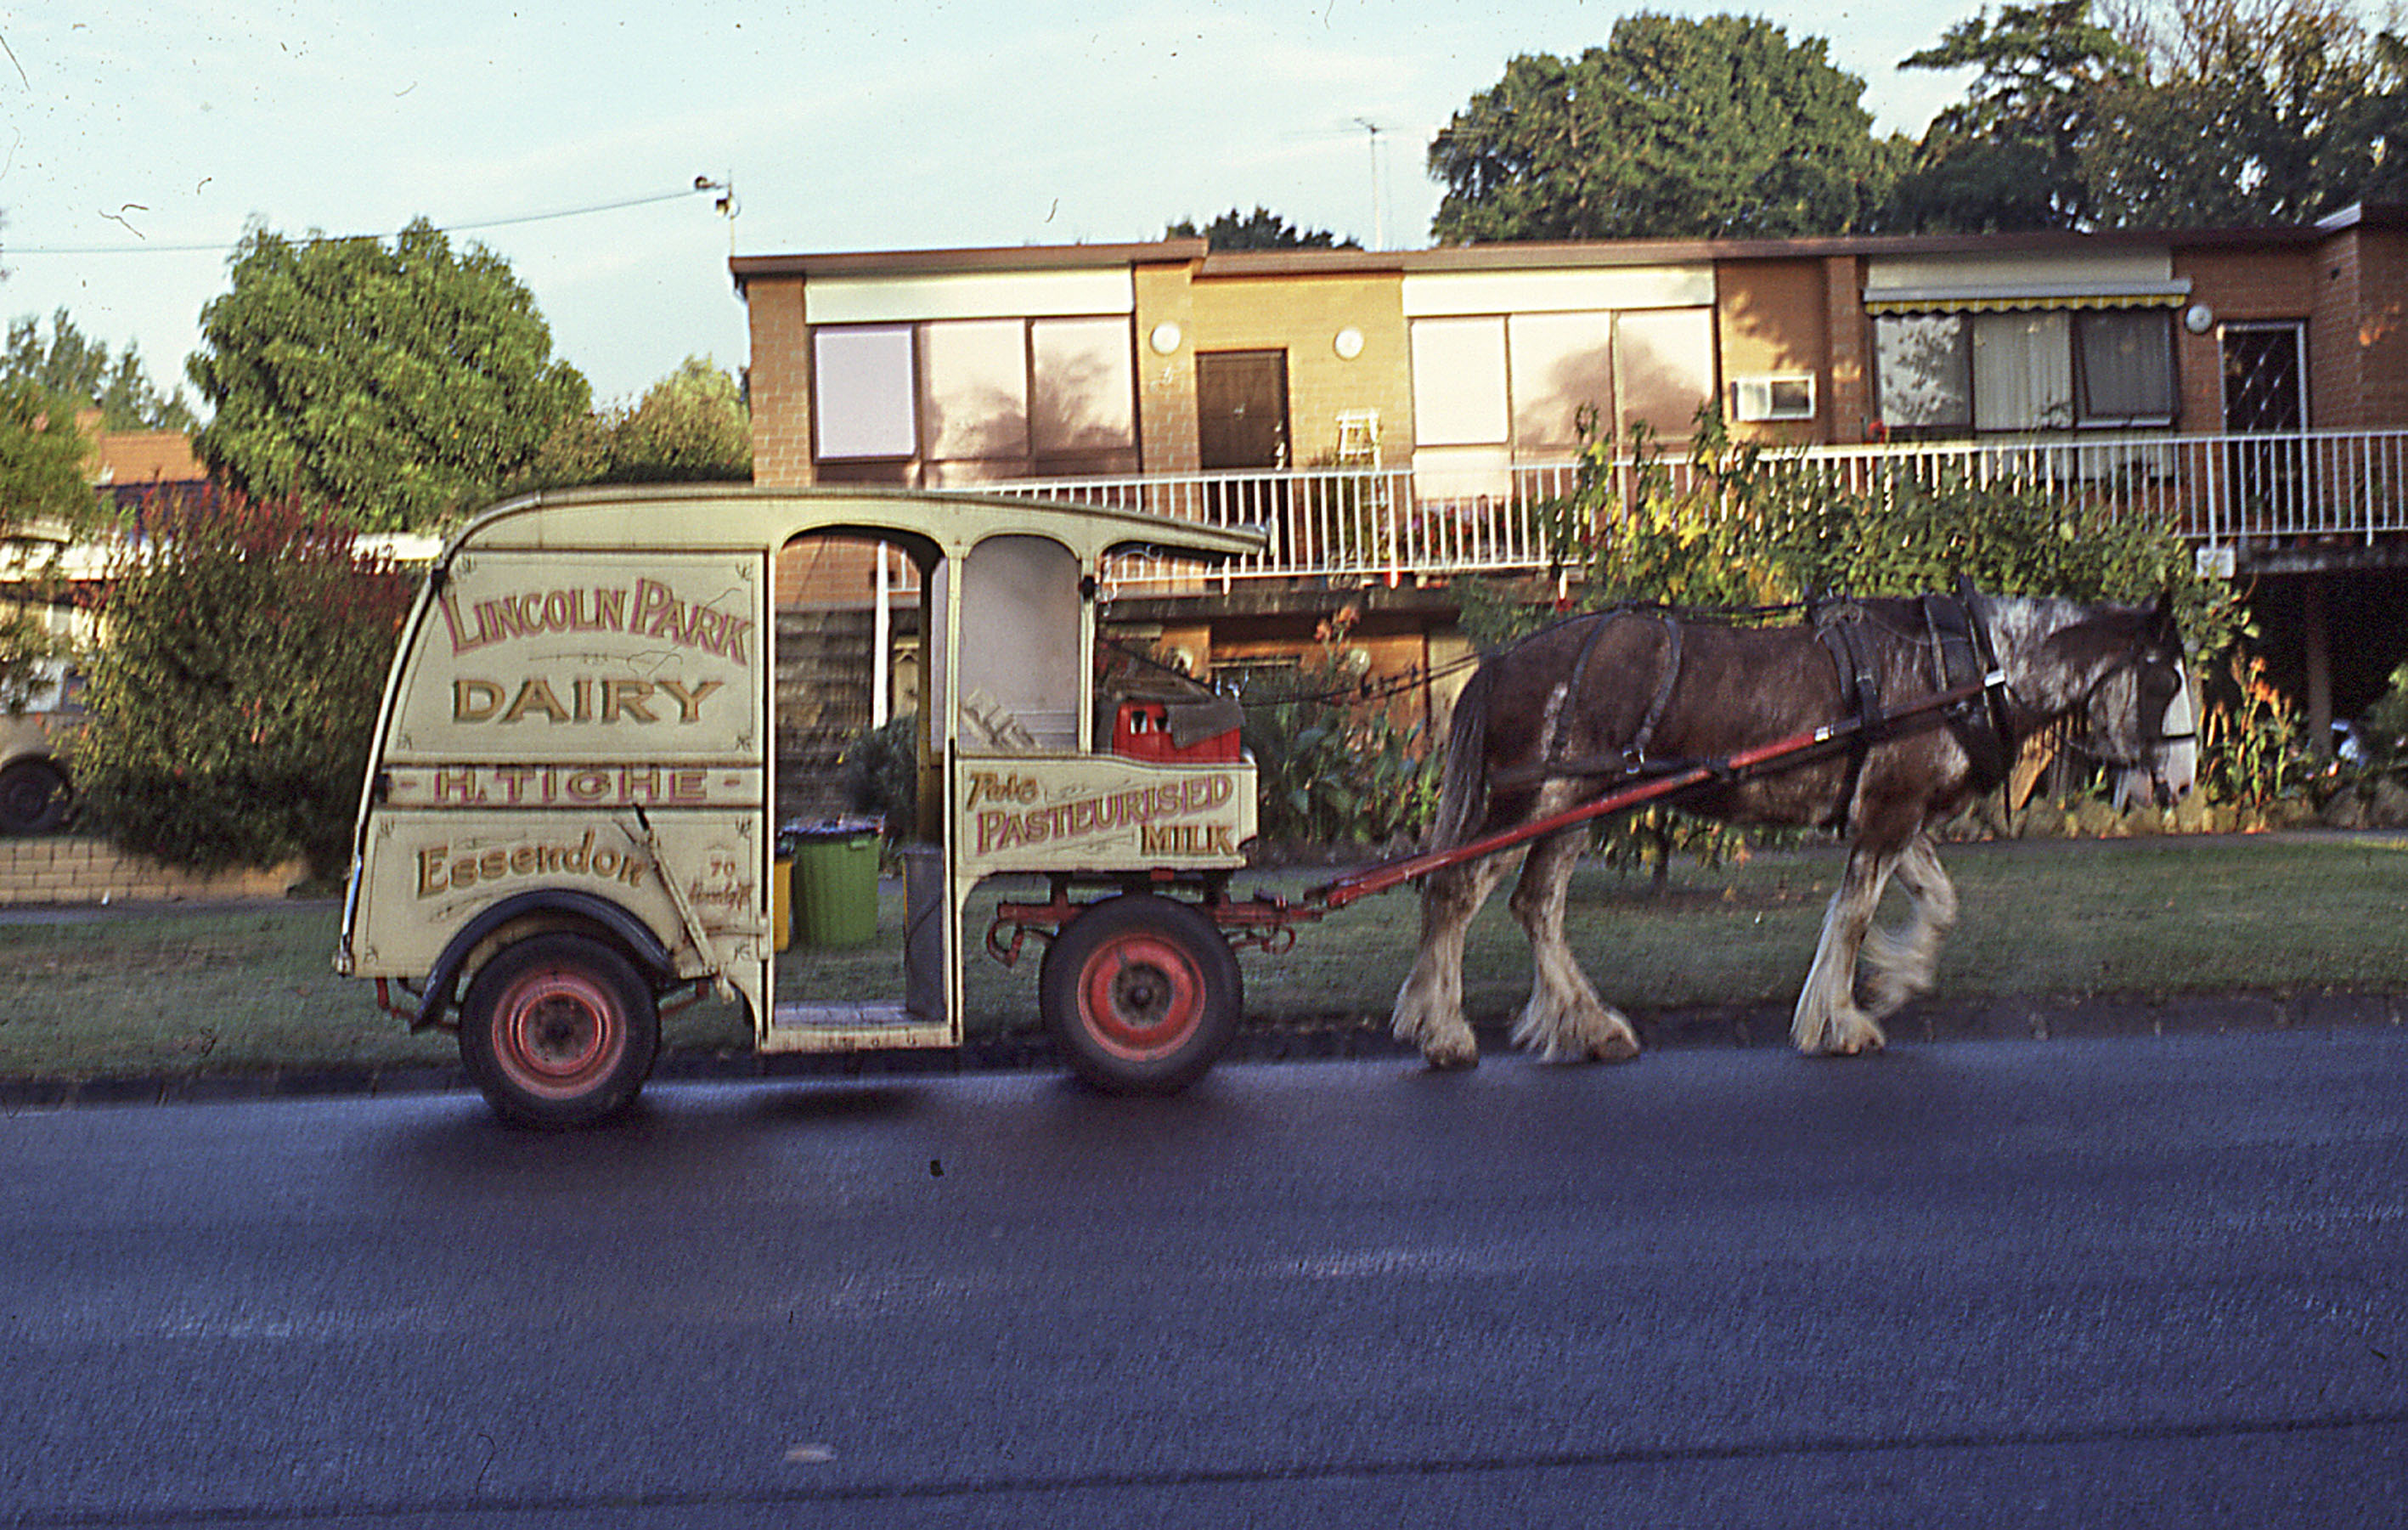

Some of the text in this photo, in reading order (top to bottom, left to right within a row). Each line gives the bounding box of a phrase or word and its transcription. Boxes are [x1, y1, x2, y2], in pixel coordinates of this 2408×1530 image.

[437, 577, 755, 666] LINCOLN PARK
[453, 678, 725, 725] DAIRY
[434, 766, 708, 804] H. TIGHE
[977, 774, 1234, 856] PASTEURISED
[1141, 823, 1235, 856] MILK
[416, 828, 649, 900] Essendon
